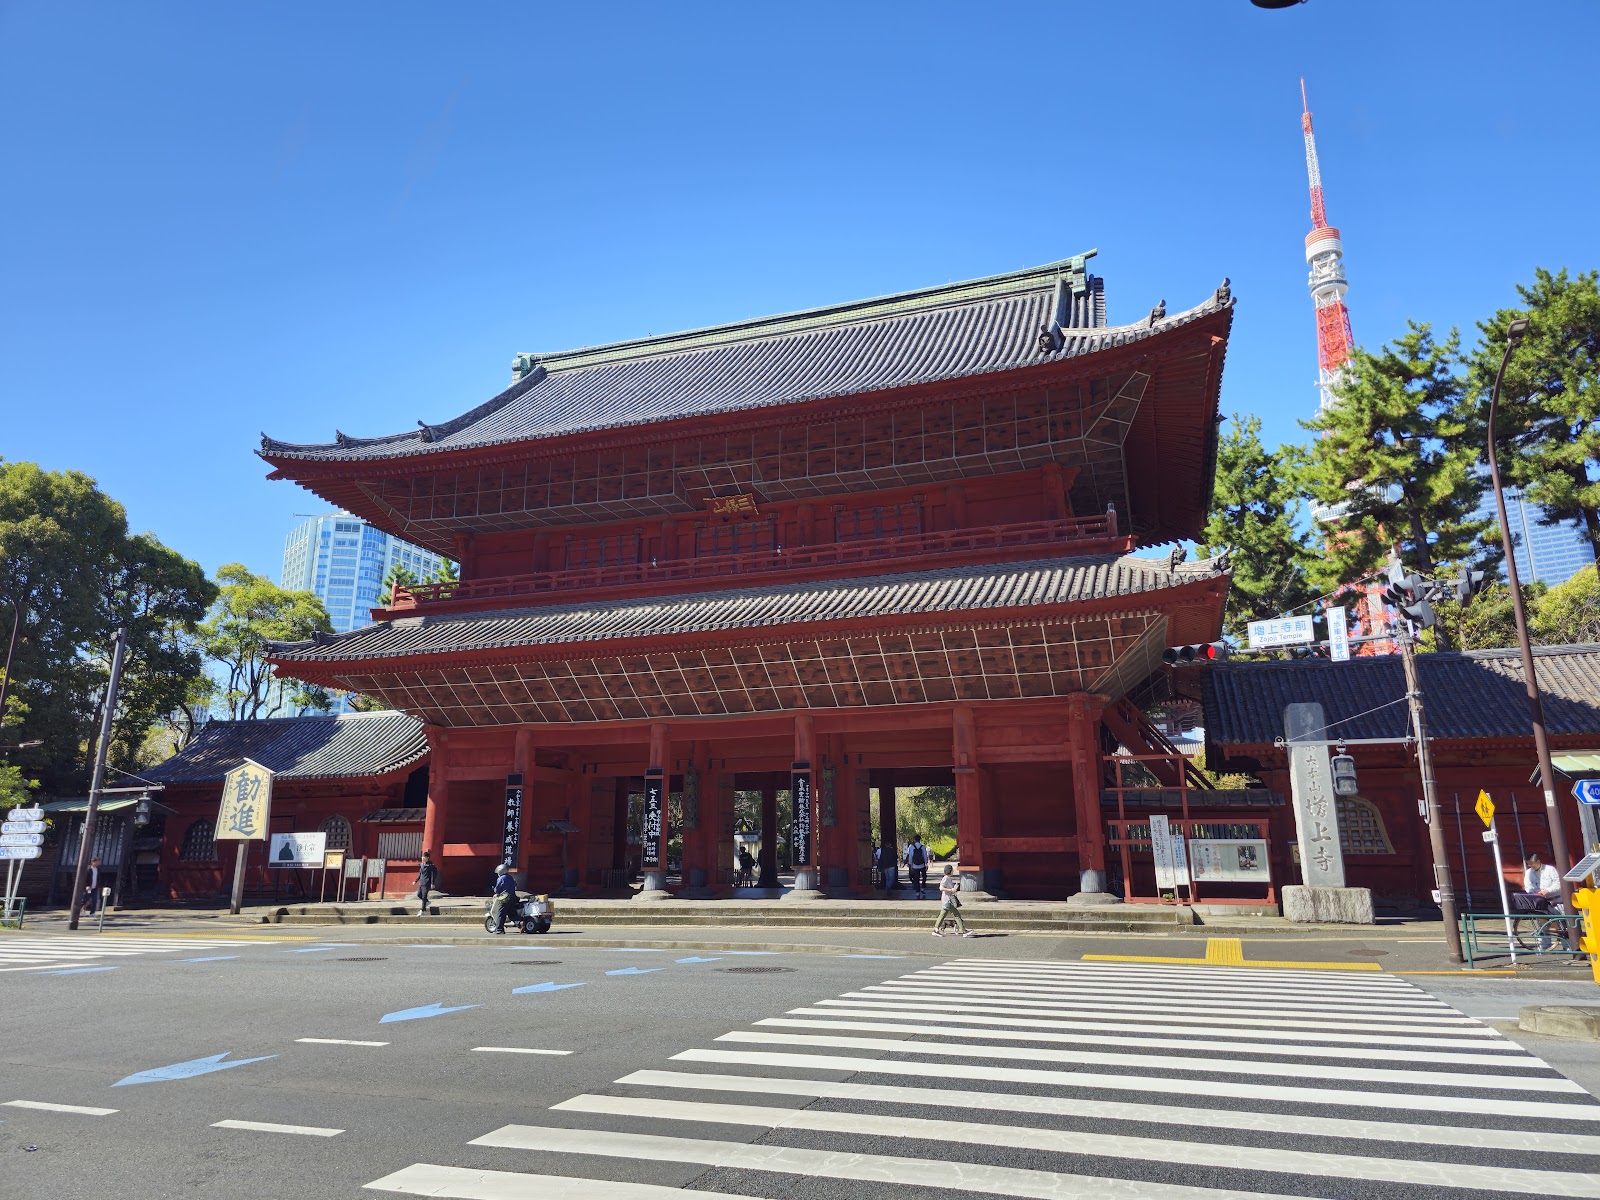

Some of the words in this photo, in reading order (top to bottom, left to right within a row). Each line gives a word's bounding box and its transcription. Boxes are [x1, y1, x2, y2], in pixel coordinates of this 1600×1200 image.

[1254, 620, 1307, 636] 増上寺前
[1279, 633, 1303, 641] Temple
[1589, 787, 1600, 796] 40
[228, 769, 262, 837] 勧進
